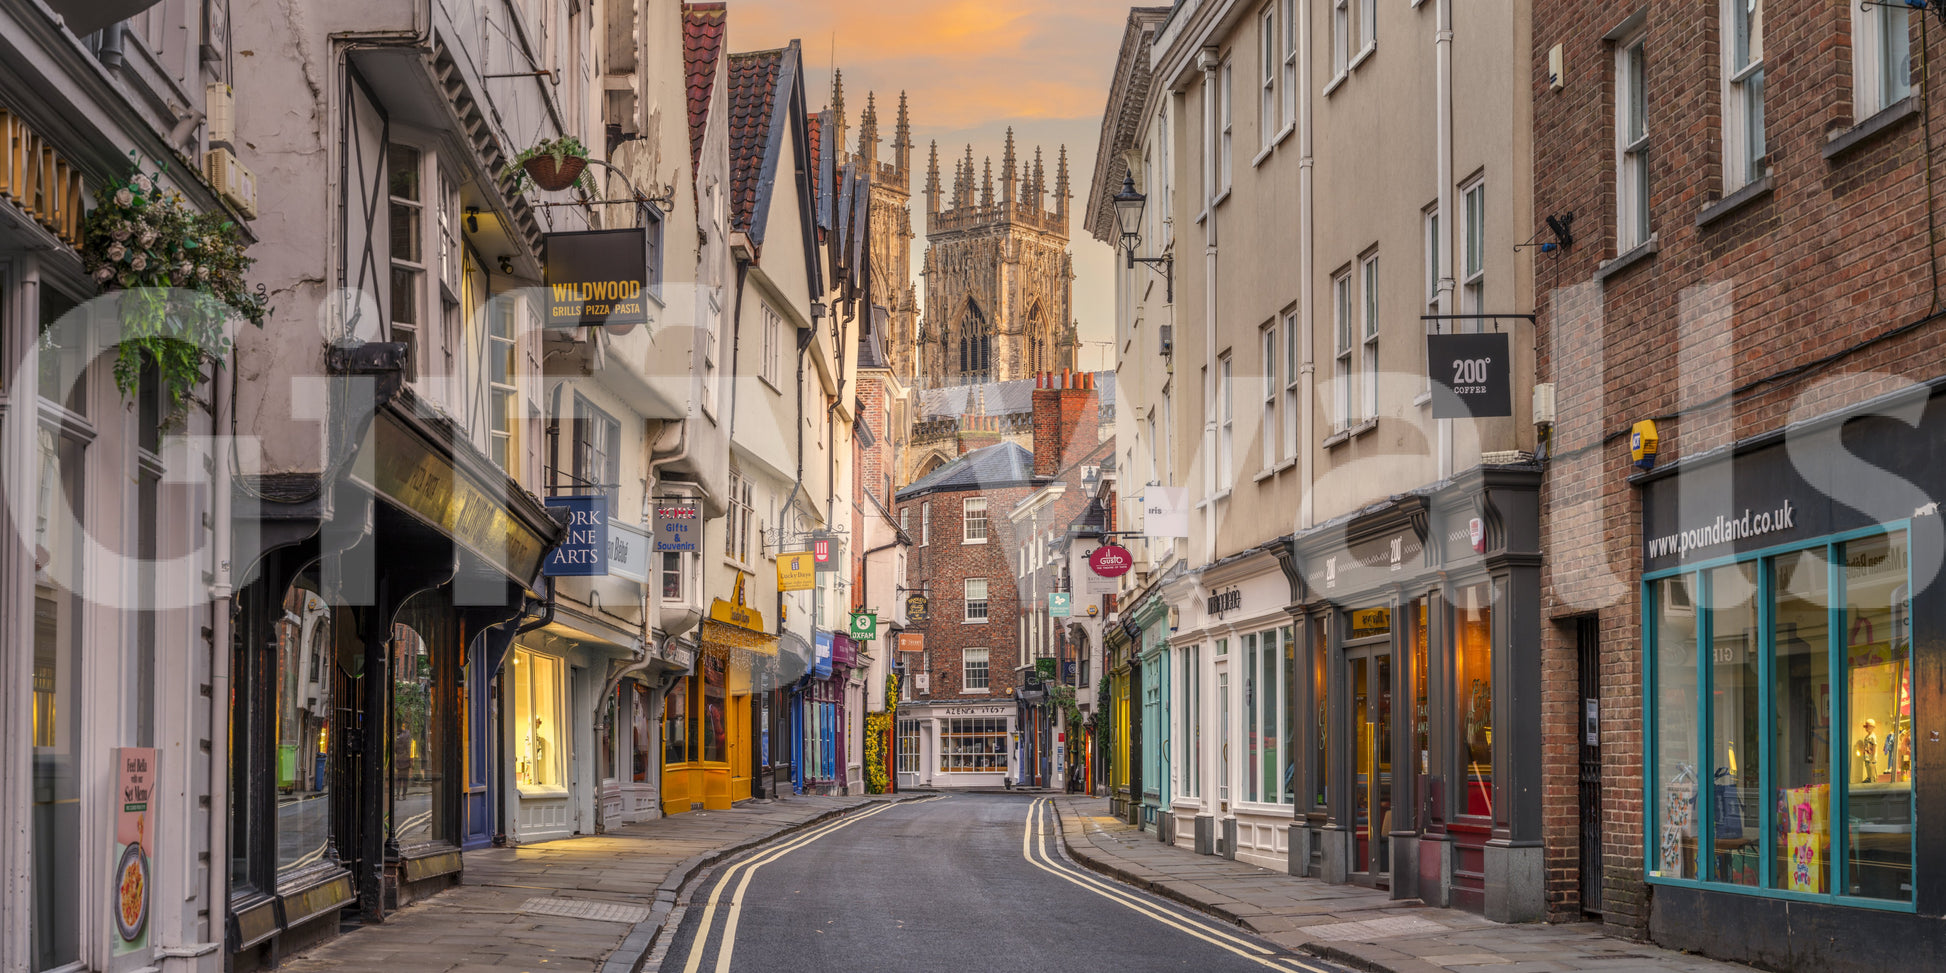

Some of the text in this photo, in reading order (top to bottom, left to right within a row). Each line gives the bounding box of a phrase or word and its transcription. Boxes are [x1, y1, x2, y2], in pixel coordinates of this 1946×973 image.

[552, 280, 640, 302] WILDWOOD
[552, 303, 640, 317] GRILLS PIZZA PASTA
[1453, 386, 1487, 394] COFFEE
[657, 507, 697, 520] YORK
[665, 523, 688, 532] Gifts
[1648, 499, 1794, 559] www.poundland.co.uk
[564, 530, 597, 545] INE
[674, 533, 681, 543] &
[657, 541, 696, 550] Souvenirs
[552, 547, 598, 564] ARTS
